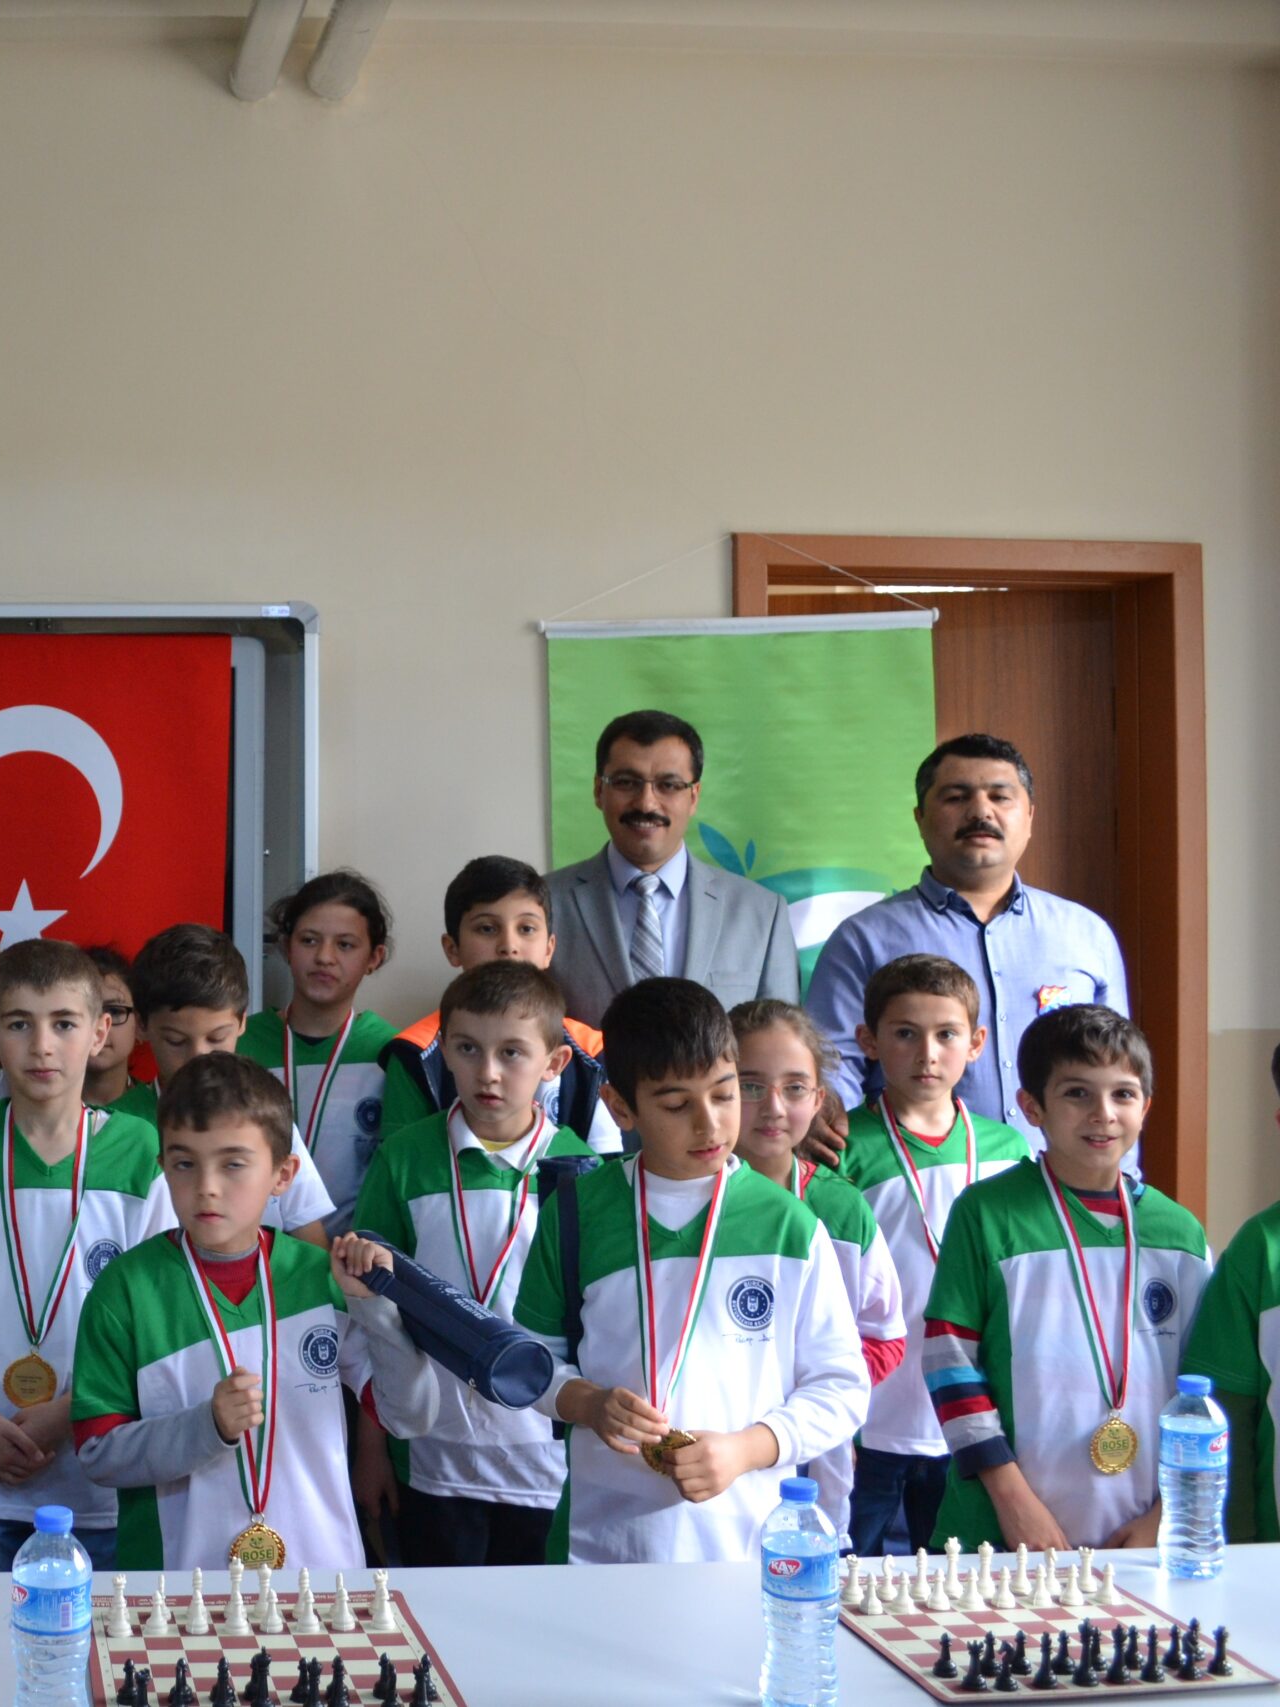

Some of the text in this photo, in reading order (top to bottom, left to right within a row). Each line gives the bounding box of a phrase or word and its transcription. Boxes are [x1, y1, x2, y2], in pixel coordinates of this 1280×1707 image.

[743, 1280, 764, 1289] BURSA
[1103, 1439, 1128, 1451] BOSE
[242, 1548, 272, 1562] BOSE
[771, 1560, 797, 1576] KAY
